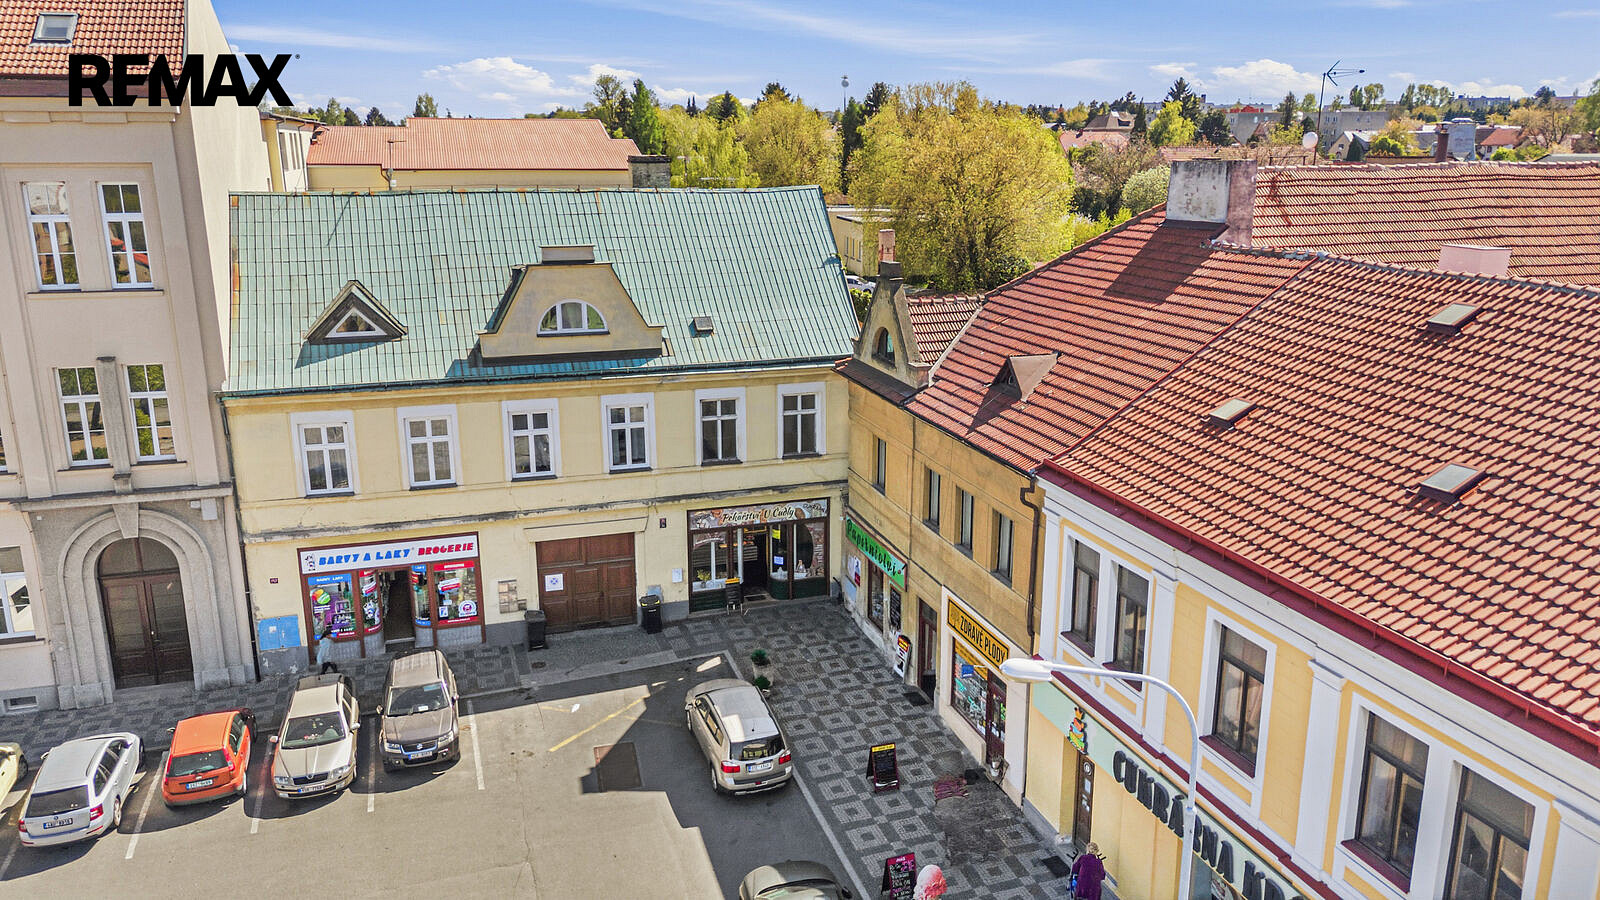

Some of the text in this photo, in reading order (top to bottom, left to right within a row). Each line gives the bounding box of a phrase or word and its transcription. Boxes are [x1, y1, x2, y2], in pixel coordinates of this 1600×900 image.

[319, 542, 474, 565] BARVY A LAKY DROGERIE
[961, 615, 984, 649] ZDRAVÉ
[984, 636, 1006, 663] PLODY
